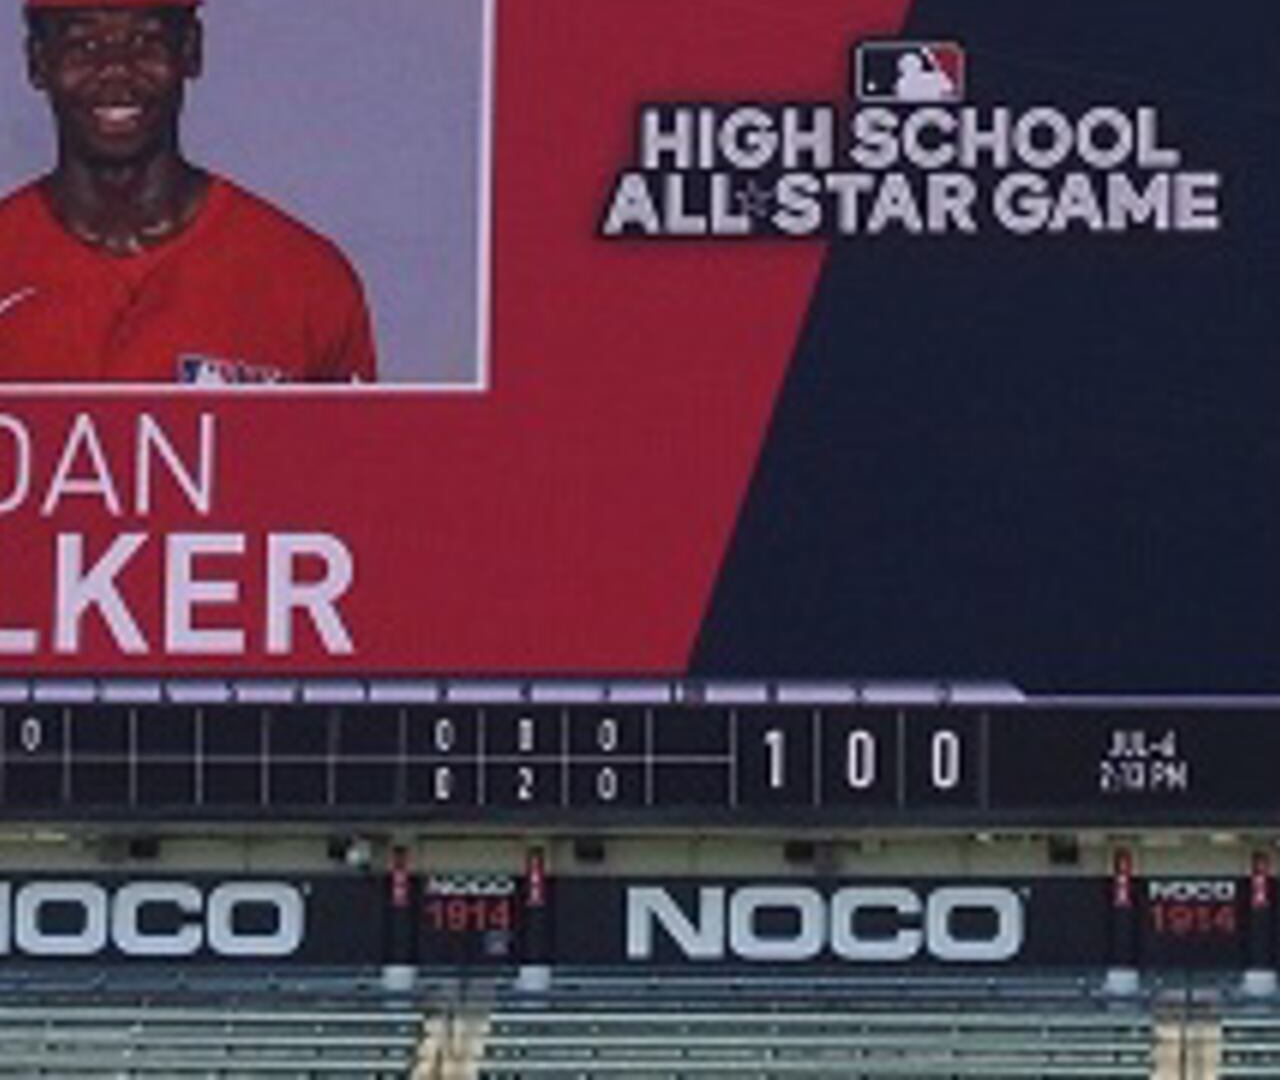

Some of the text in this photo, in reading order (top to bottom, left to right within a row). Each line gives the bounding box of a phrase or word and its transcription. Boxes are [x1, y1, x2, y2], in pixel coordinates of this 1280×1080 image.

[641, 106, 1180, 169] HIGH SCHOOL
[993, 172, 1221, 232] GAME
[21, 718, 41, 752] 0
[435, 718, 455, 752] 0
[597, 718, 617, 752] 0
[764, 730, 959, 788] 1 0 0
[519, 767, 534, 800] 2
[597, 767, 617, 800] 0
[1150, 761, 1188, 791] PM
[1148, 881, 1236, 901] NOCO
[425, 899, 510, 931] 1914
[626, 886, 1024, 962] NOCO
[1151, 904, 1235, 933] 1914
